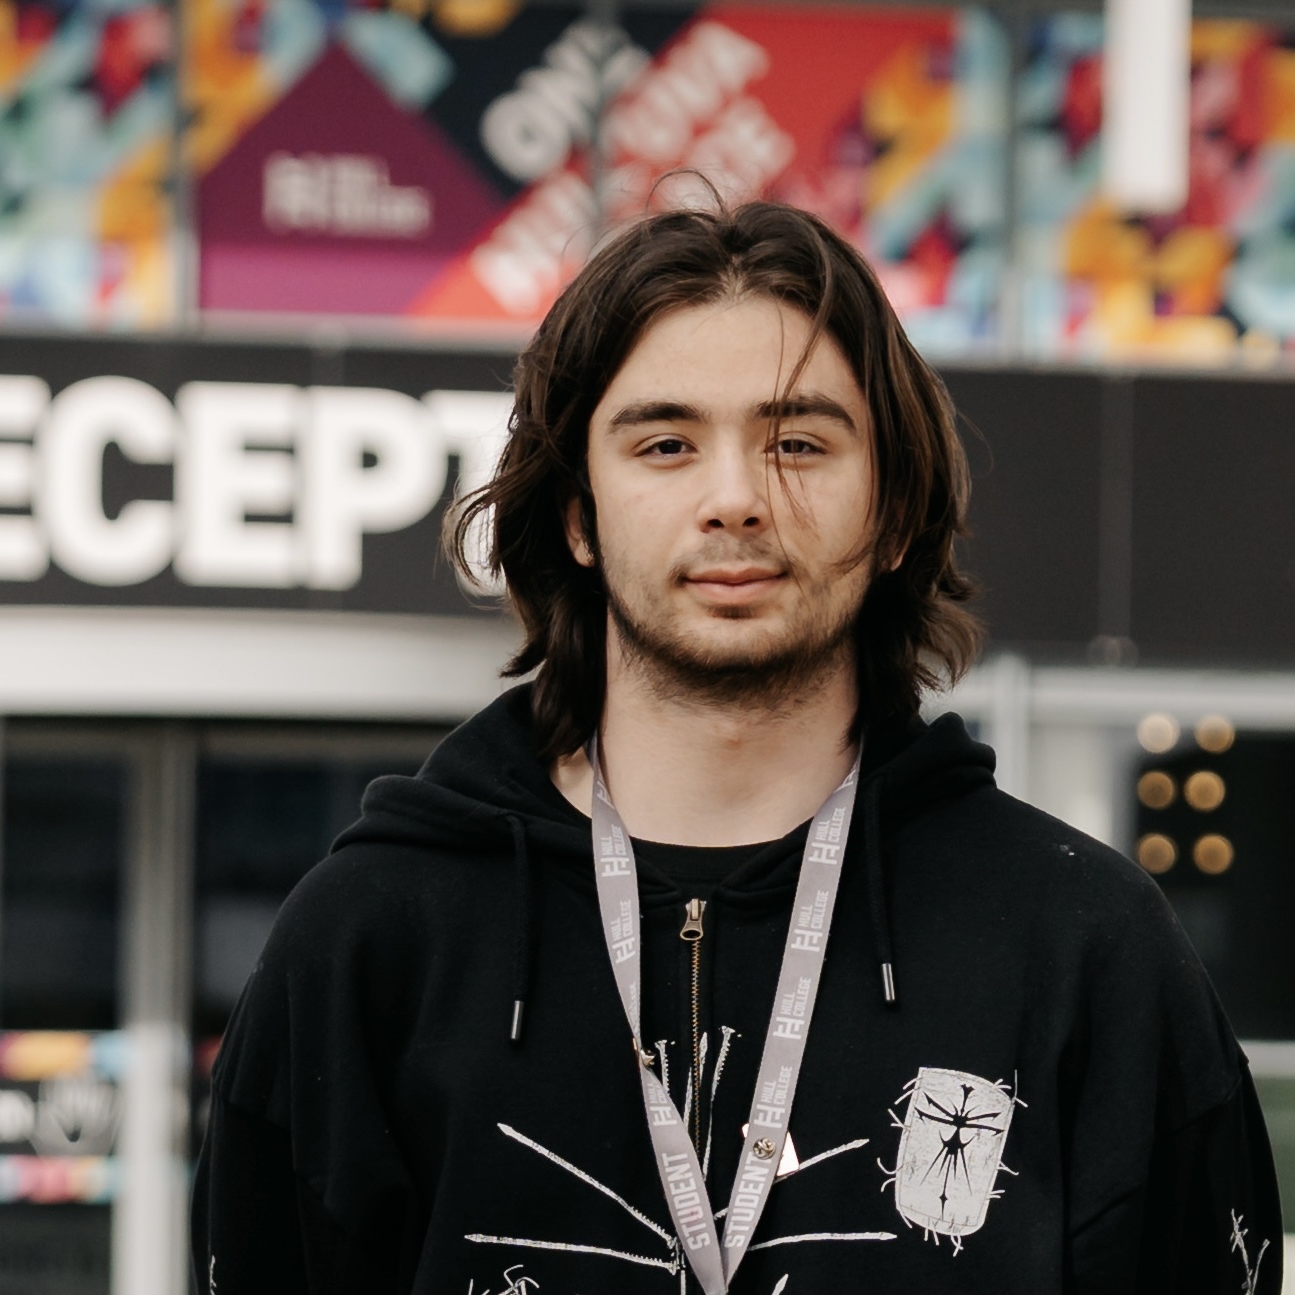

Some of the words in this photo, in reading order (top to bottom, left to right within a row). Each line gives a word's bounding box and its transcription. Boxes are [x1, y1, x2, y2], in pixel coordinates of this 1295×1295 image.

[814, 819, 831, 842] HULL
[827, 806, 848, 844] COLLEGE
[619, 899, 634, 937] COLLEGE
[798, 904, 814, 928] HULL
[810, 889, 830, 930] COLLEGE
[610, 919, 622, 940] HULL
[780, 992, 797, 1016] HULL
[792, 976, 812, 1018] COLLEGE
[761, 1080, 777, 1103] HULL
[773, 1065, 794, 1106] COLLEGE
[661, 1152, 711, 1251] STUDENT
[724, 1150, 773, 1249] STUDENT
